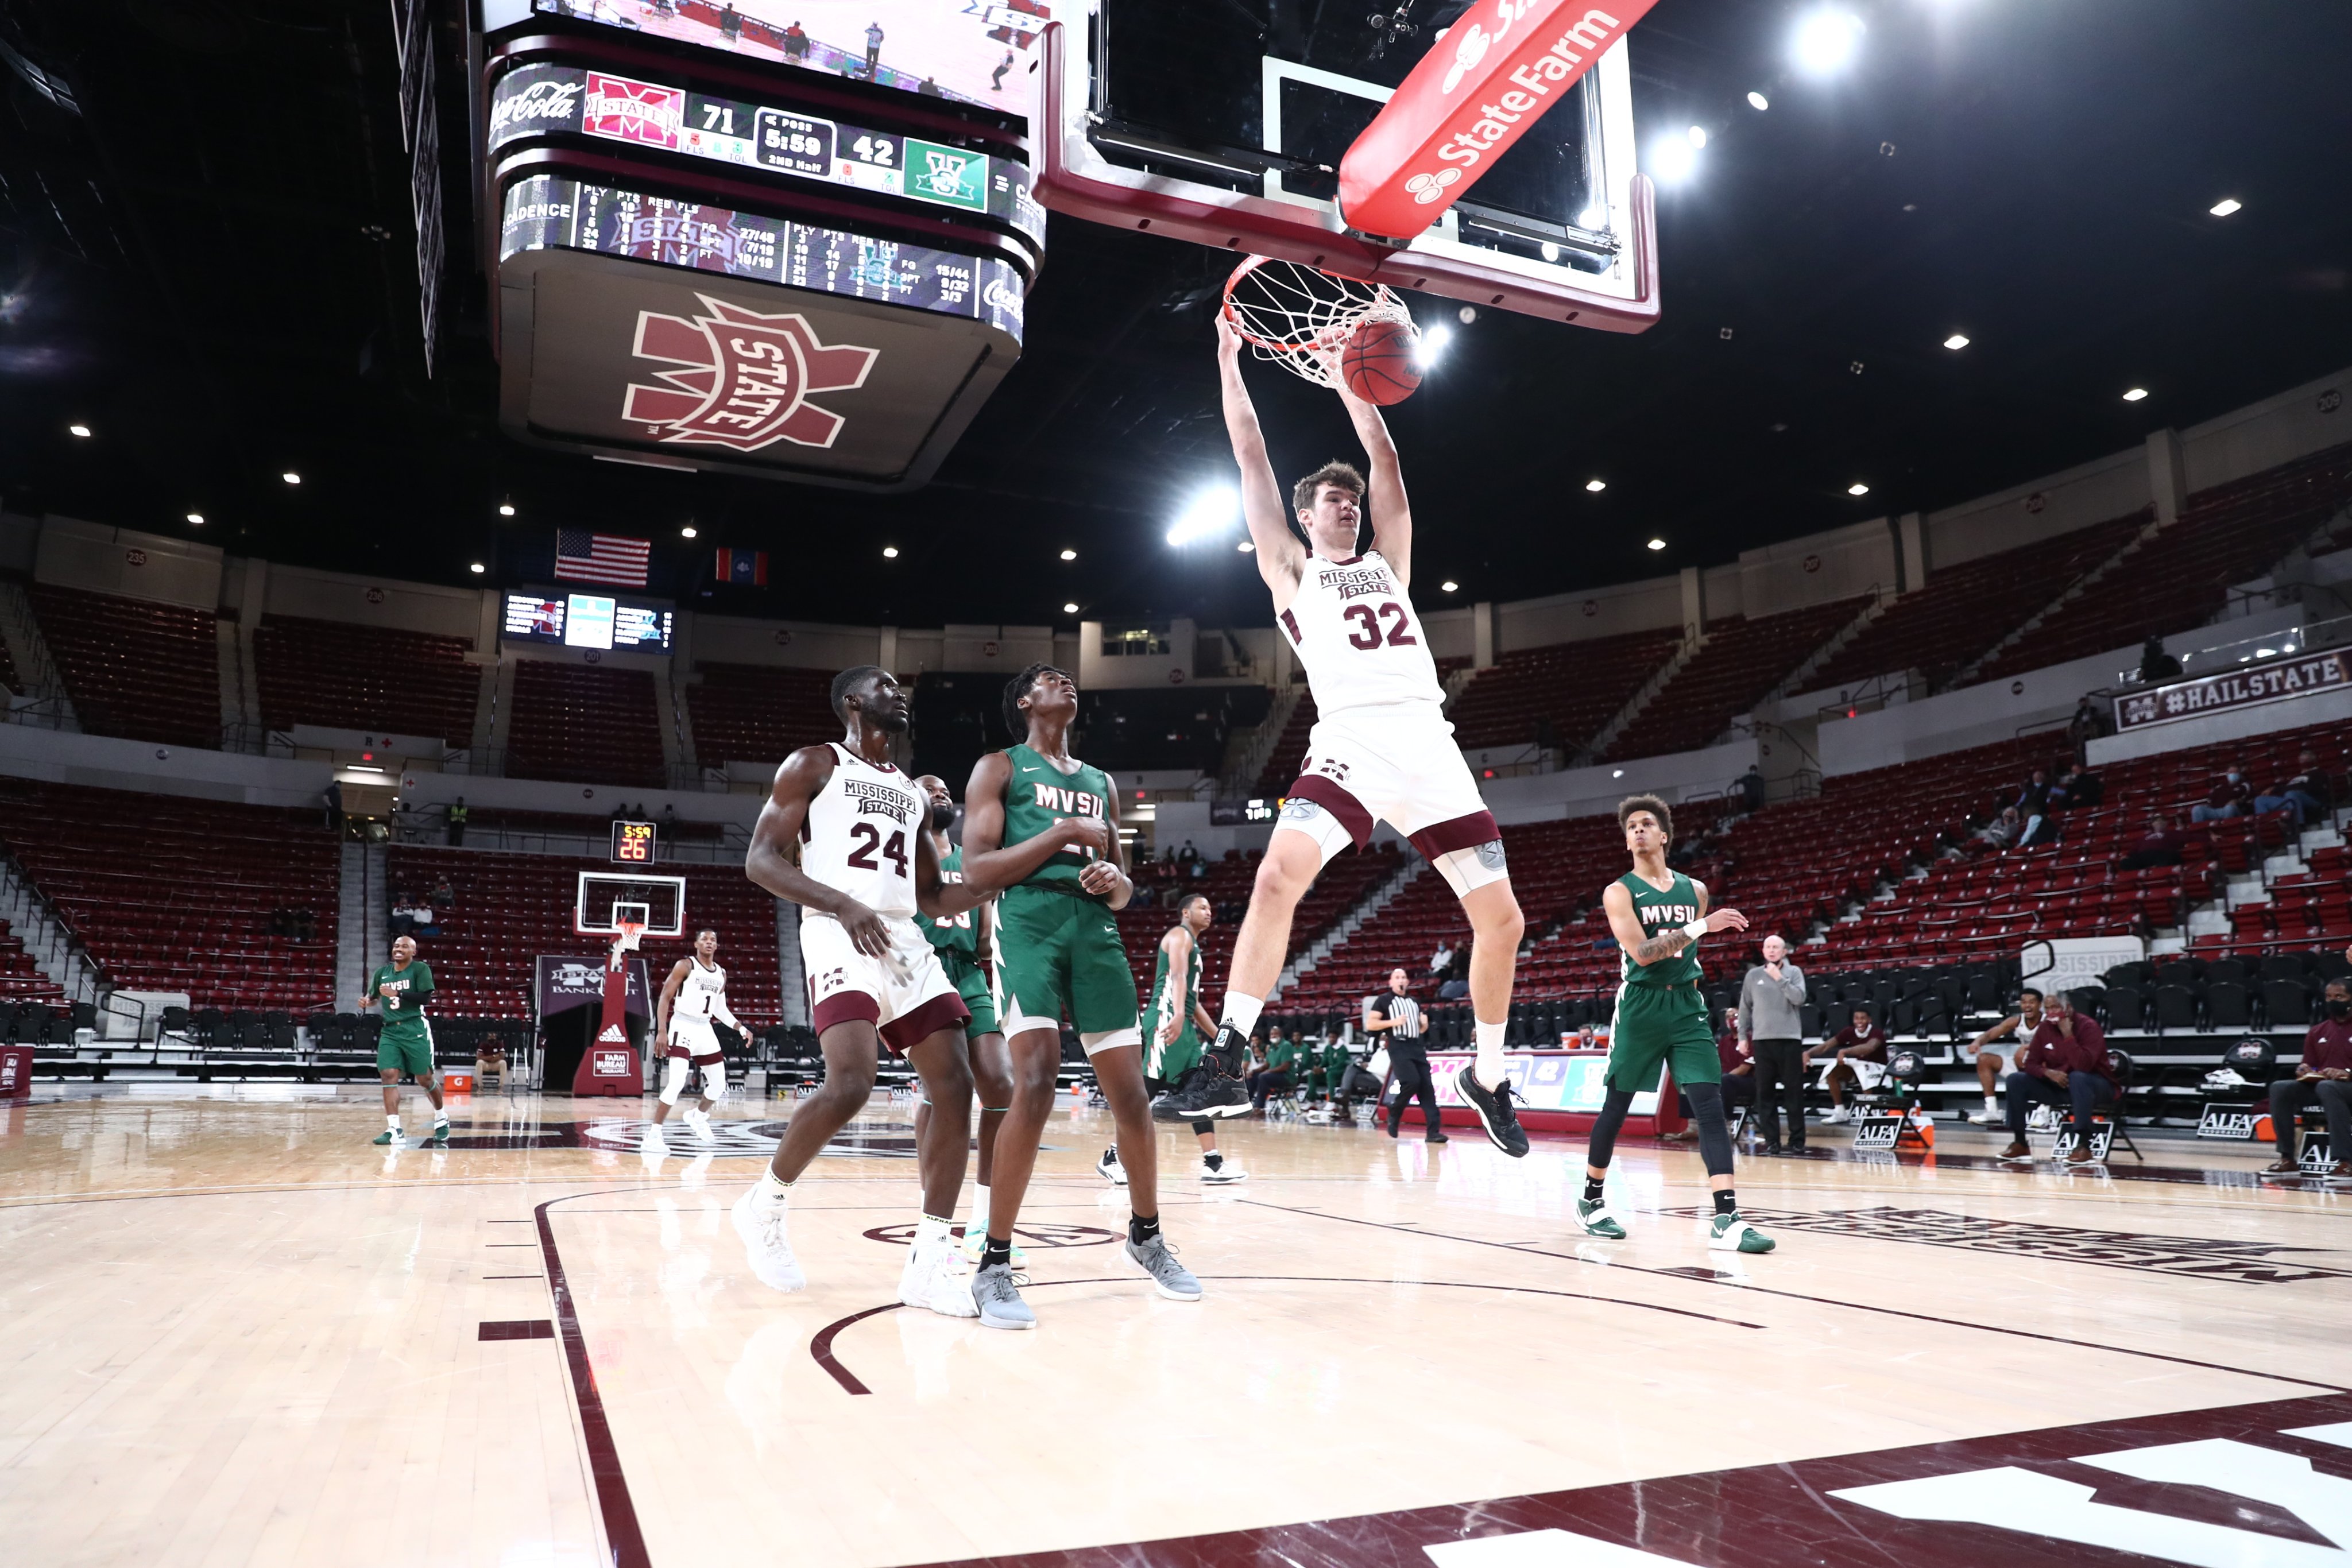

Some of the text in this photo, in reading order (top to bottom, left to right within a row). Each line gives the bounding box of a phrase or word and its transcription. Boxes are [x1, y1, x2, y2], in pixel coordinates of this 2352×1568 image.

[604, 100, 662, 122] STATE
[703, 103, 733, 134] 71
[782, 118, 813, 133] POSS
[686, 145, 704, 154] FLS
[733, 141, 742, 154] 3
[765, 128, 821, 156] 5:59
[853, 135, 893, 166] 42
[729, 153, 747, 164] TOL
[768, 154, 794, 168] 2ND
[838, 176, 855, 185] FLS
[884, 172, 893, 185] 2
[880, 184, 898, 193] TOL
[584, 185, 699, 214] PLY PTS REB FLS
[506, 203, 571, 226] CADENCE
[589, 207, 596, 216] 1
[702, 223, 717, 233] FG
[583, 227, 599, 239] 24
[621, 234, 629, 244] 4
[680, 244, 688, 254] 2
[680, 234, 687, 243] 1
[700, 236, 721, 247] 3PT
[794, 224, 899, 251] PLY PTS REB FLS
[799, 234, 806, 243] 3
[830, 239, 837, 249] 7
[583, 238, 597, 250] 32
[652, 250, 659, 261] 1
[699, 249, 713, 259] FT
[826, 249, 840, 260] 14
[794, 254, 807, 265] 11
[825, 260, 839, 270] 17
[902, 260, 969, 280] FG 15/44
[900, 273, 920, 284] 3PT
[856, 287, 863, 297] 2
[881, 291, 889, 301] 2
[900, 285, 962, 303] FT 3/3
[704, 338, 788, 429] STATE
[2319, 393, 2340, 411] 209
[128, 552, 145, 562] 235
[1348, 583, 1389, 595] STATE
[368, 592, 382, 602] 236
[1343, 602, 1417, 651] 32
[365, 737, 373, 746] R
[844, 781, 916, 812] MISSISSIPPI
[1034, 783, 1103, 820] MVSU
[866, 802, 900, 820] STATE
[625, 826, 651, 838] 5:59
[620, 838, 645, 859] 26
[848, 822, 908, 878] 24
[1641, 905, 1695, 925] MVSU
[389, 996, 400, 1009] 3
[702, 996, 711, 1014] 1
[454, 1078, 463, 1086] G
[2203, 1113, 2252, 1129] ALFA
[1858, 1125, 1895, 1139] ALFA
